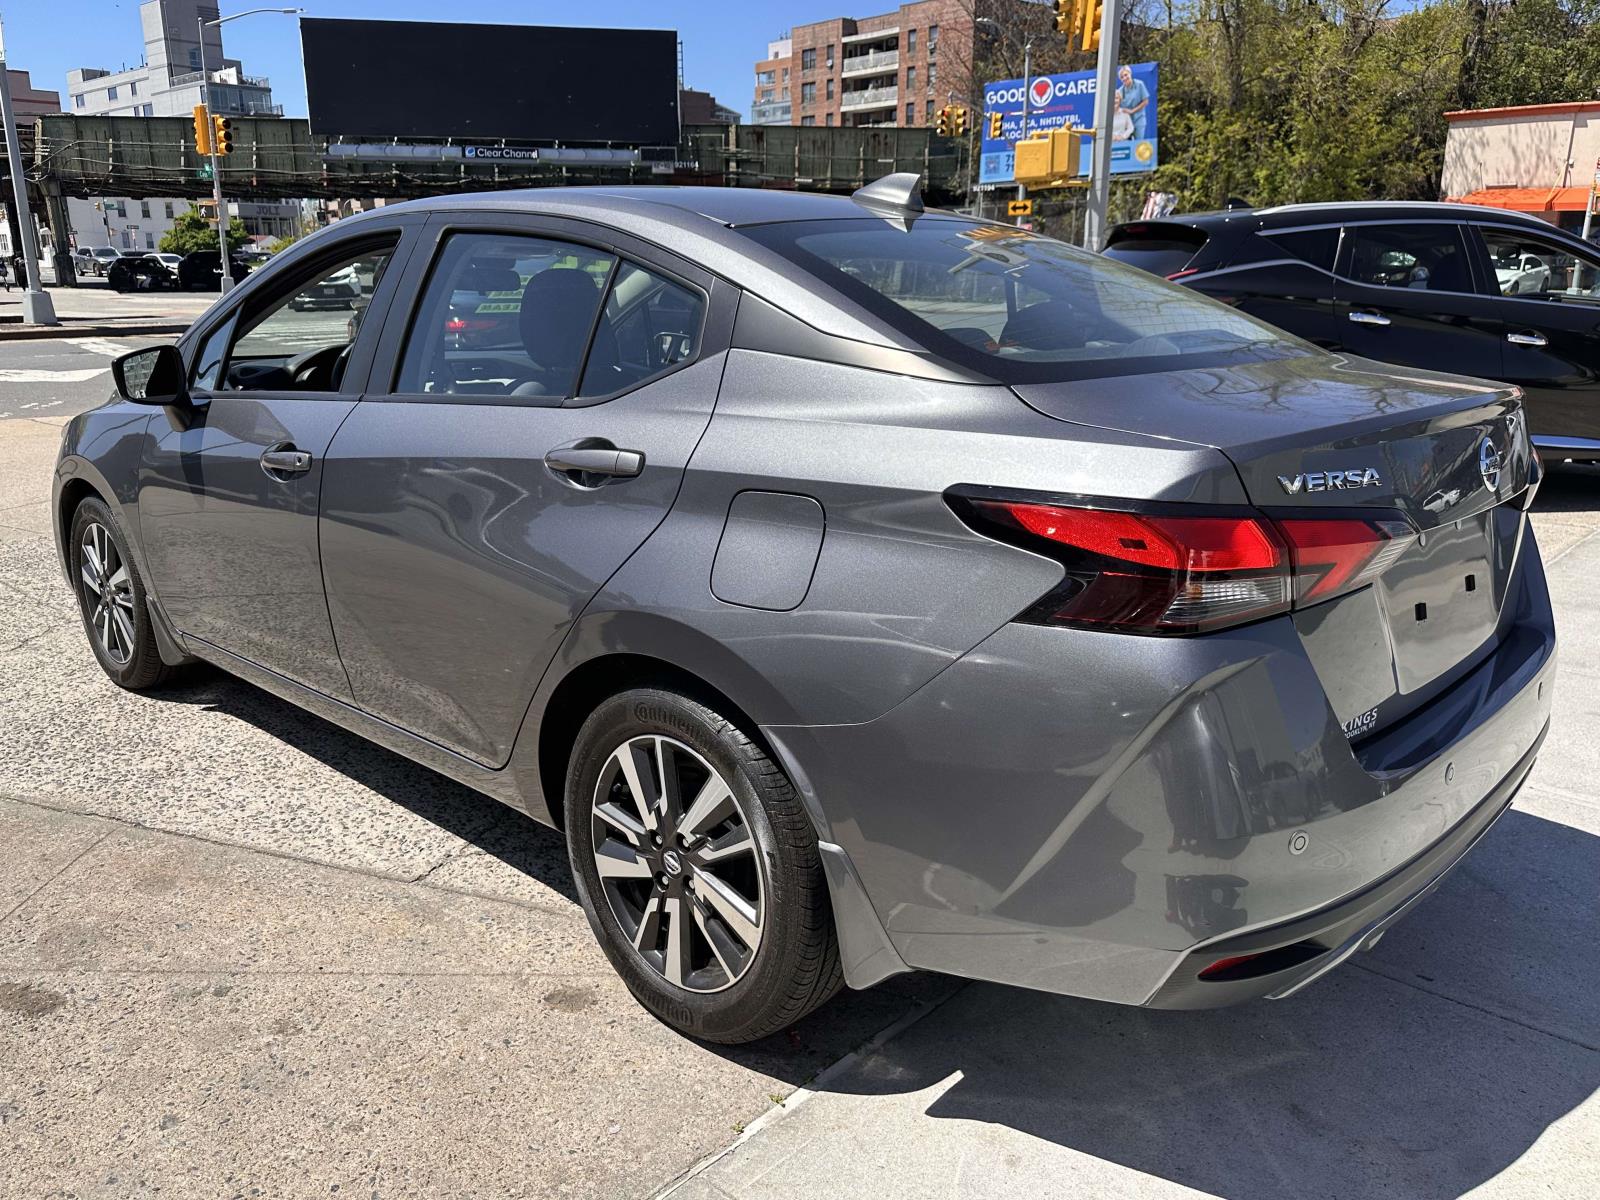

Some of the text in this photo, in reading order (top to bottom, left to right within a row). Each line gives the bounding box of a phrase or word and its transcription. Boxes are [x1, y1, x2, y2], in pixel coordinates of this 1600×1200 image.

[986, 78, 1097, 104] GOOD CARE
[477, 148, 502, 158] Clear
[1277, 467, 1382, 495] VERSA
[1341, 708, 1378, 732] KINGS
